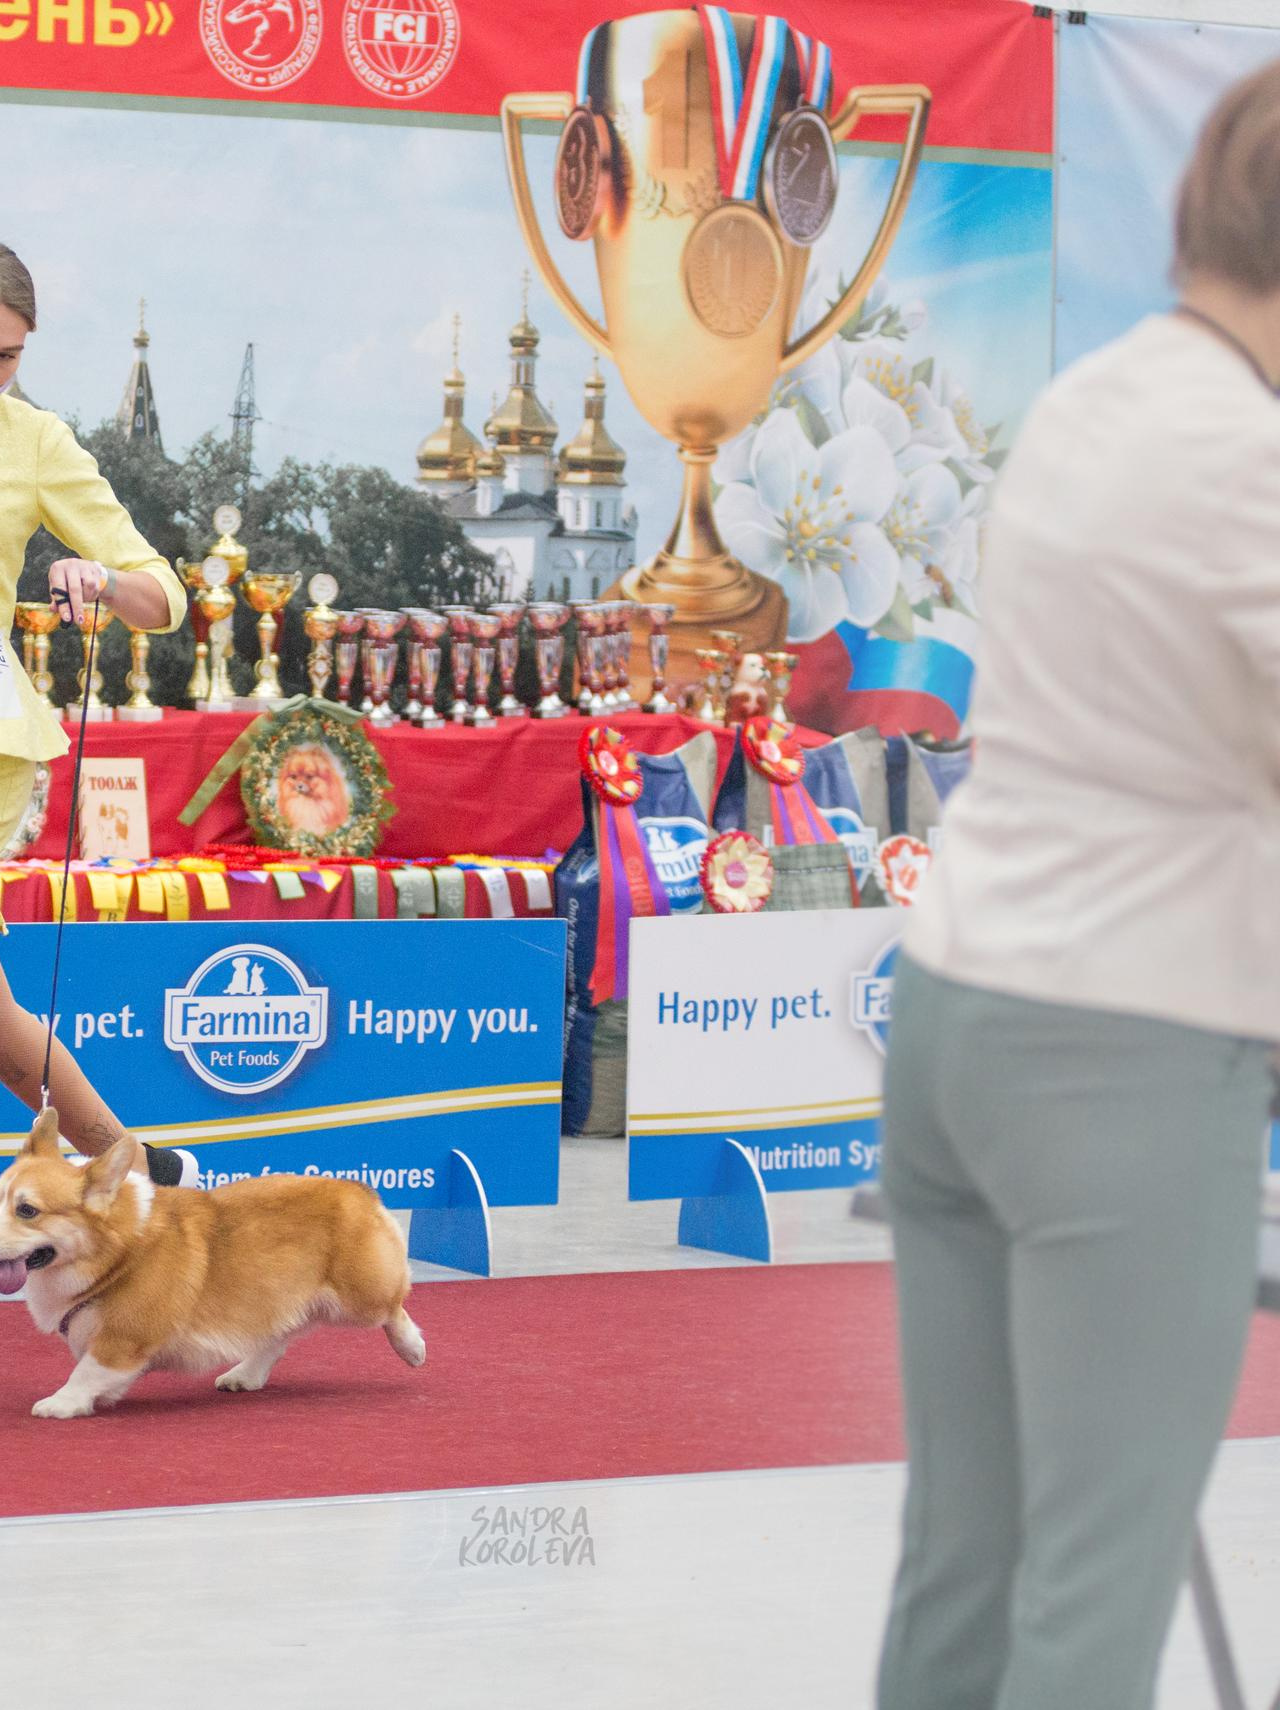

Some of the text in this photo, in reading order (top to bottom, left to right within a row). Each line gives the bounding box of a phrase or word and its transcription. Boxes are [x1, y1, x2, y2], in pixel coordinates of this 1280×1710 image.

[374, 12, 428, 43] FCI
[74, 1004, 144, 1049] pet.
[181, 1001, 310, 1036] Farmina
[348, 1000, 457, 1044] Happy
[467, 1008, 539, 1044] you.
[658, 991, 758, 1032] Happy
[771, 988, 832, 1029] pet.
[210, 1050, 280, 1067] Pet Foods
[745, 1142, 841, 1172] Nutrition
